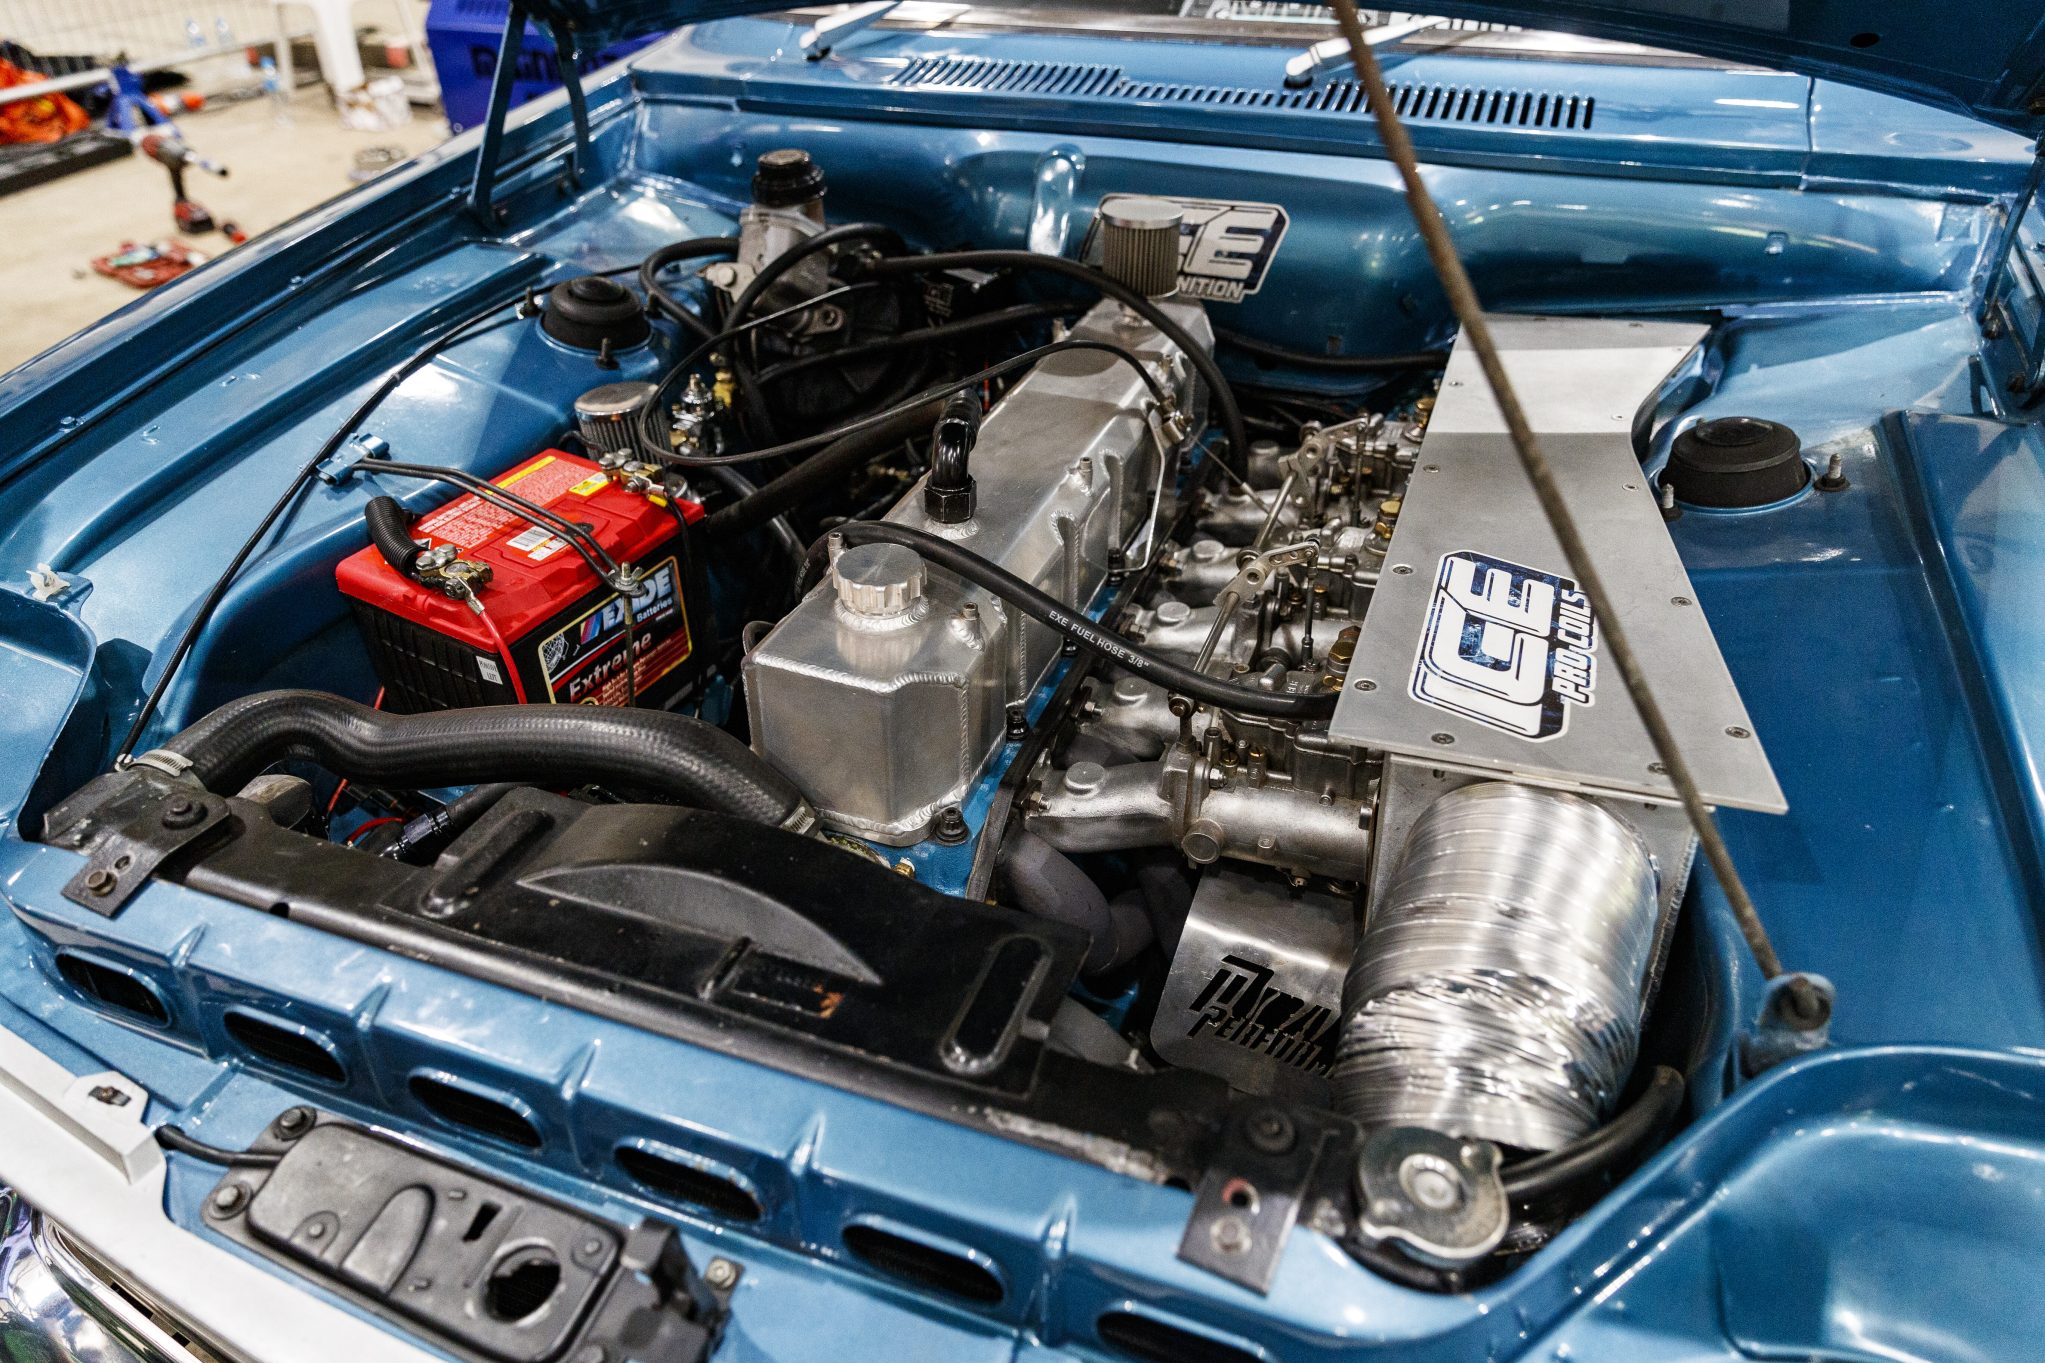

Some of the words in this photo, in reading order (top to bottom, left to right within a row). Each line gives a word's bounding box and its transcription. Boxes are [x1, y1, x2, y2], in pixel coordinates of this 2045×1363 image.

[1176, 274, 1244, 299] NITION
[636, 597, 673, 623] Batteries
[1048, 610, 1069, 627] EXE
[1070, 623, 1095, 643] FUEL
[1096, 638, 1126, 658] HOSE
